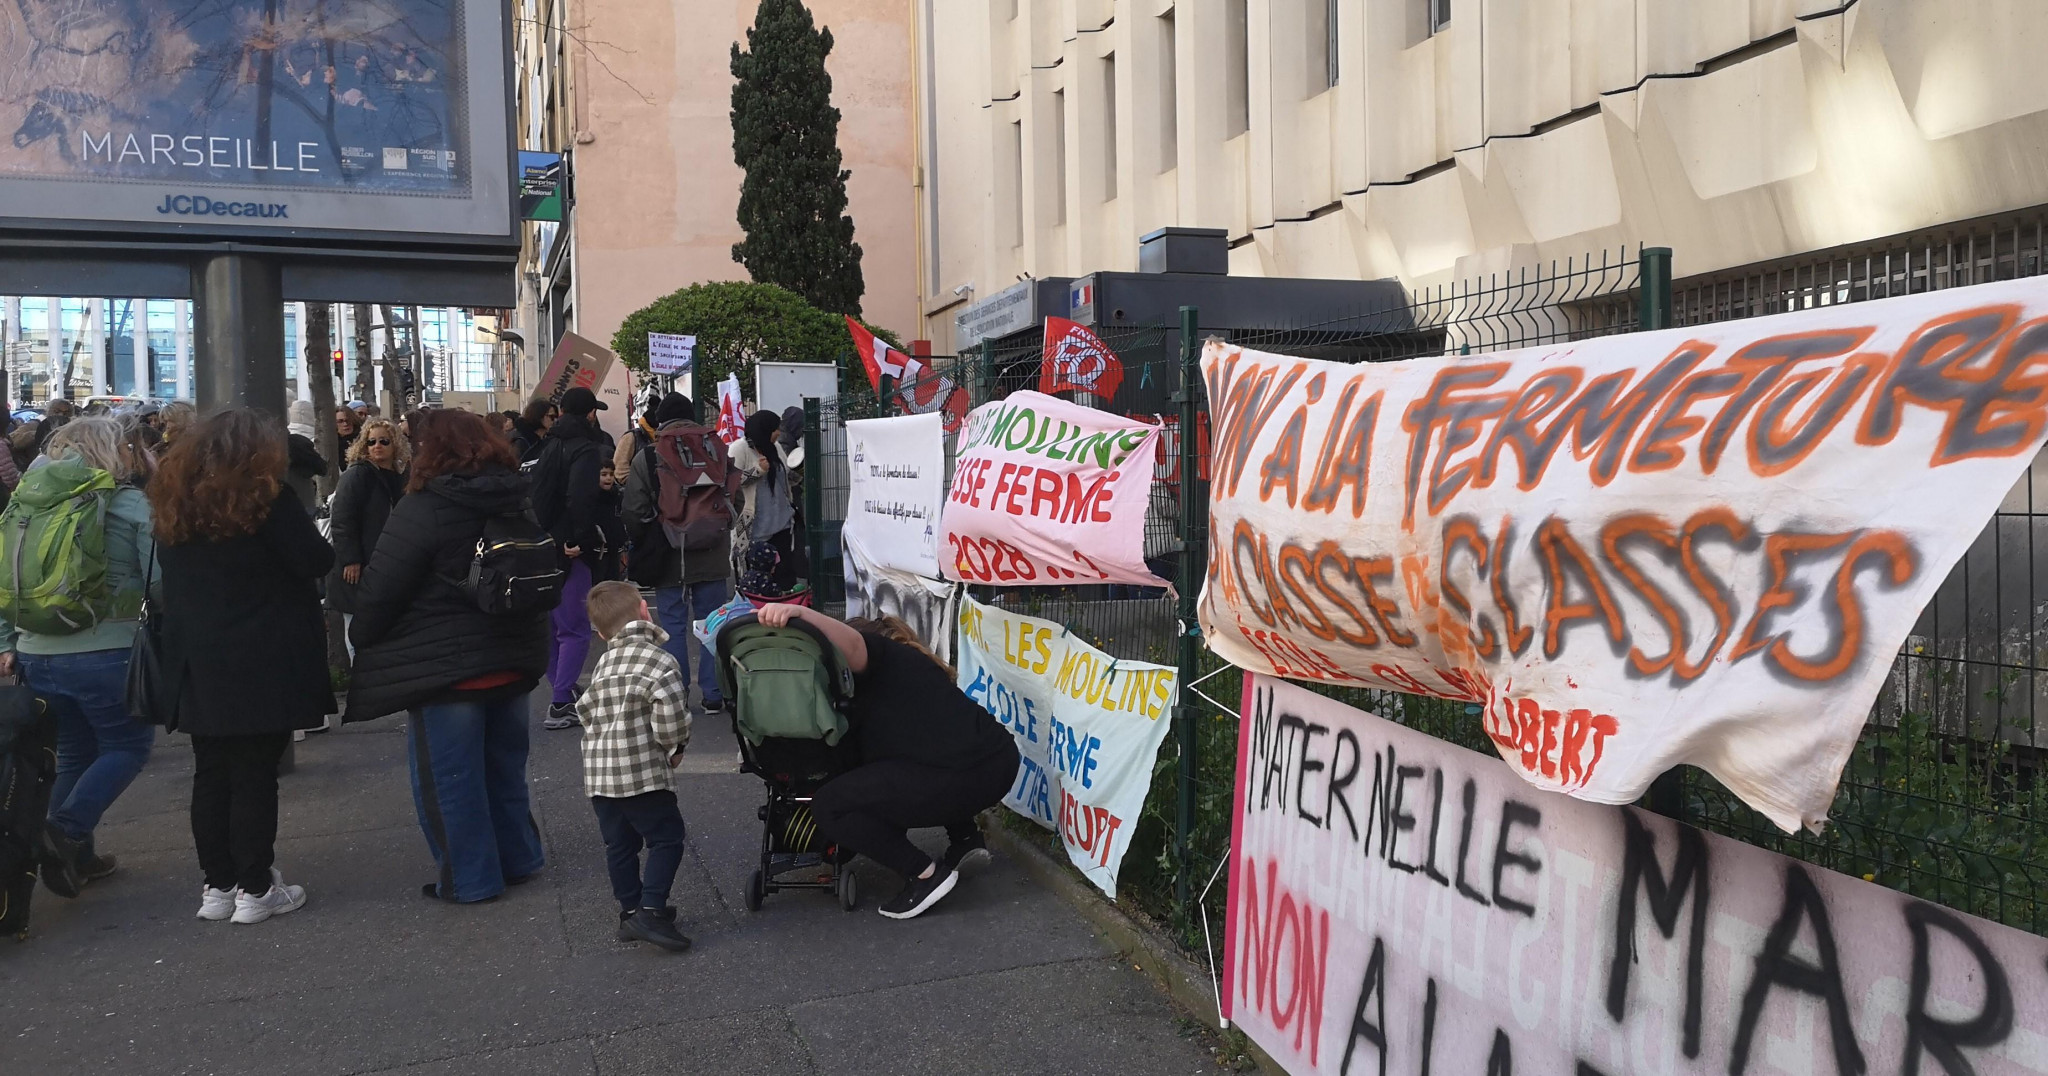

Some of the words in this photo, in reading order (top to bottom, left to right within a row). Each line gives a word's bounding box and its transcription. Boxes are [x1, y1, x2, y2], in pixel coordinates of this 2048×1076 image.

[82, 130, 320, 172] MARSEILLE
[157, 194, 289, 219] JCDecaux
[983, 403, 1150, 470] MOULINS
[1302, 373, 1385, 518] LA
[1401, 302, 2048, 534] FERMETURE
[990, 462, 1120, 525] FERME
[949, 532, 1036, 582] 2028
[1233, 518, 1420, 650] CASSE
[1439, 505, 1921, 686] CLASSES
[1003, 620, 1053, 675] LES
[1054, 645, 1174, 721] MOULINS
[1248, 686, 1542, 917] MATERNELLE
[1610, 804, 2048, 1076] MAR
[1241, 855, 1329, 1067] NON
